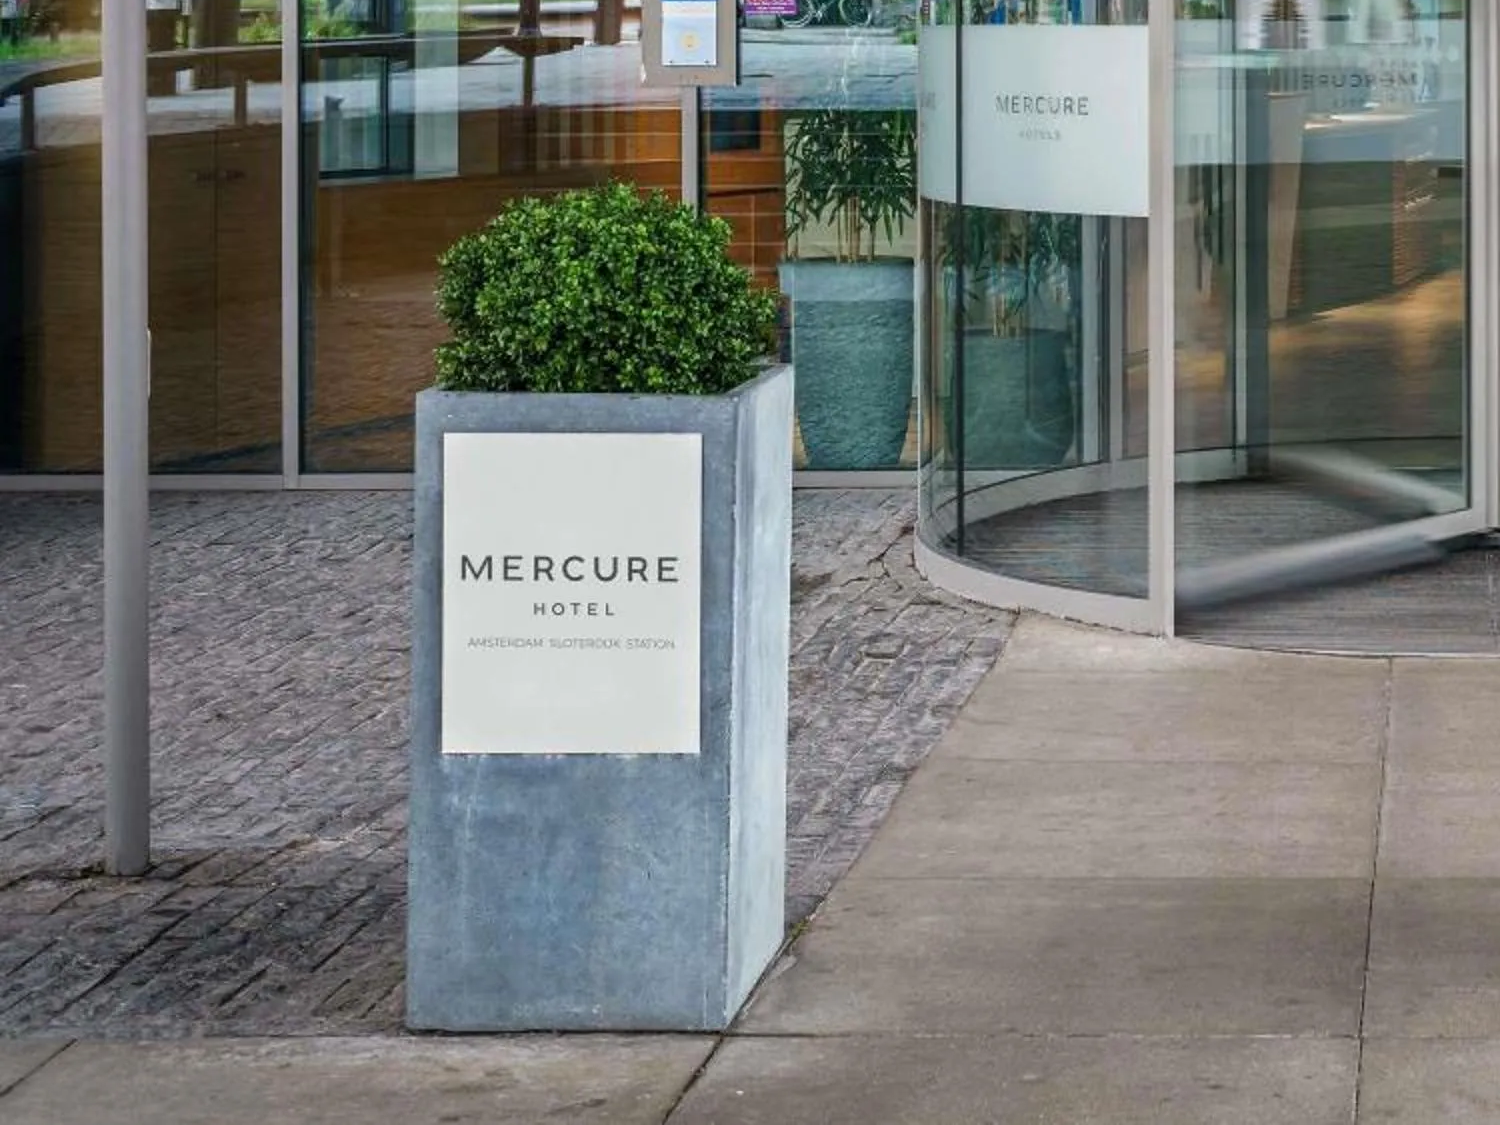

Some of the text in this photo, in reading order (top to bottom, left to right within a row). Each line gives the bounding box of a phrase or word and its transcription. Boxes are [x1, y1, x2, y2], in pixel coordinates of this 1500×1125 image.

[995, 95, 1089, 116] MERCURE
[460, 554, 679, 583] MERCURE
[532, 602, 616, 616] HOTEL
[466, 637, 544, 649] AMSTERDAM
[626, 638, 676, 650] STATION
